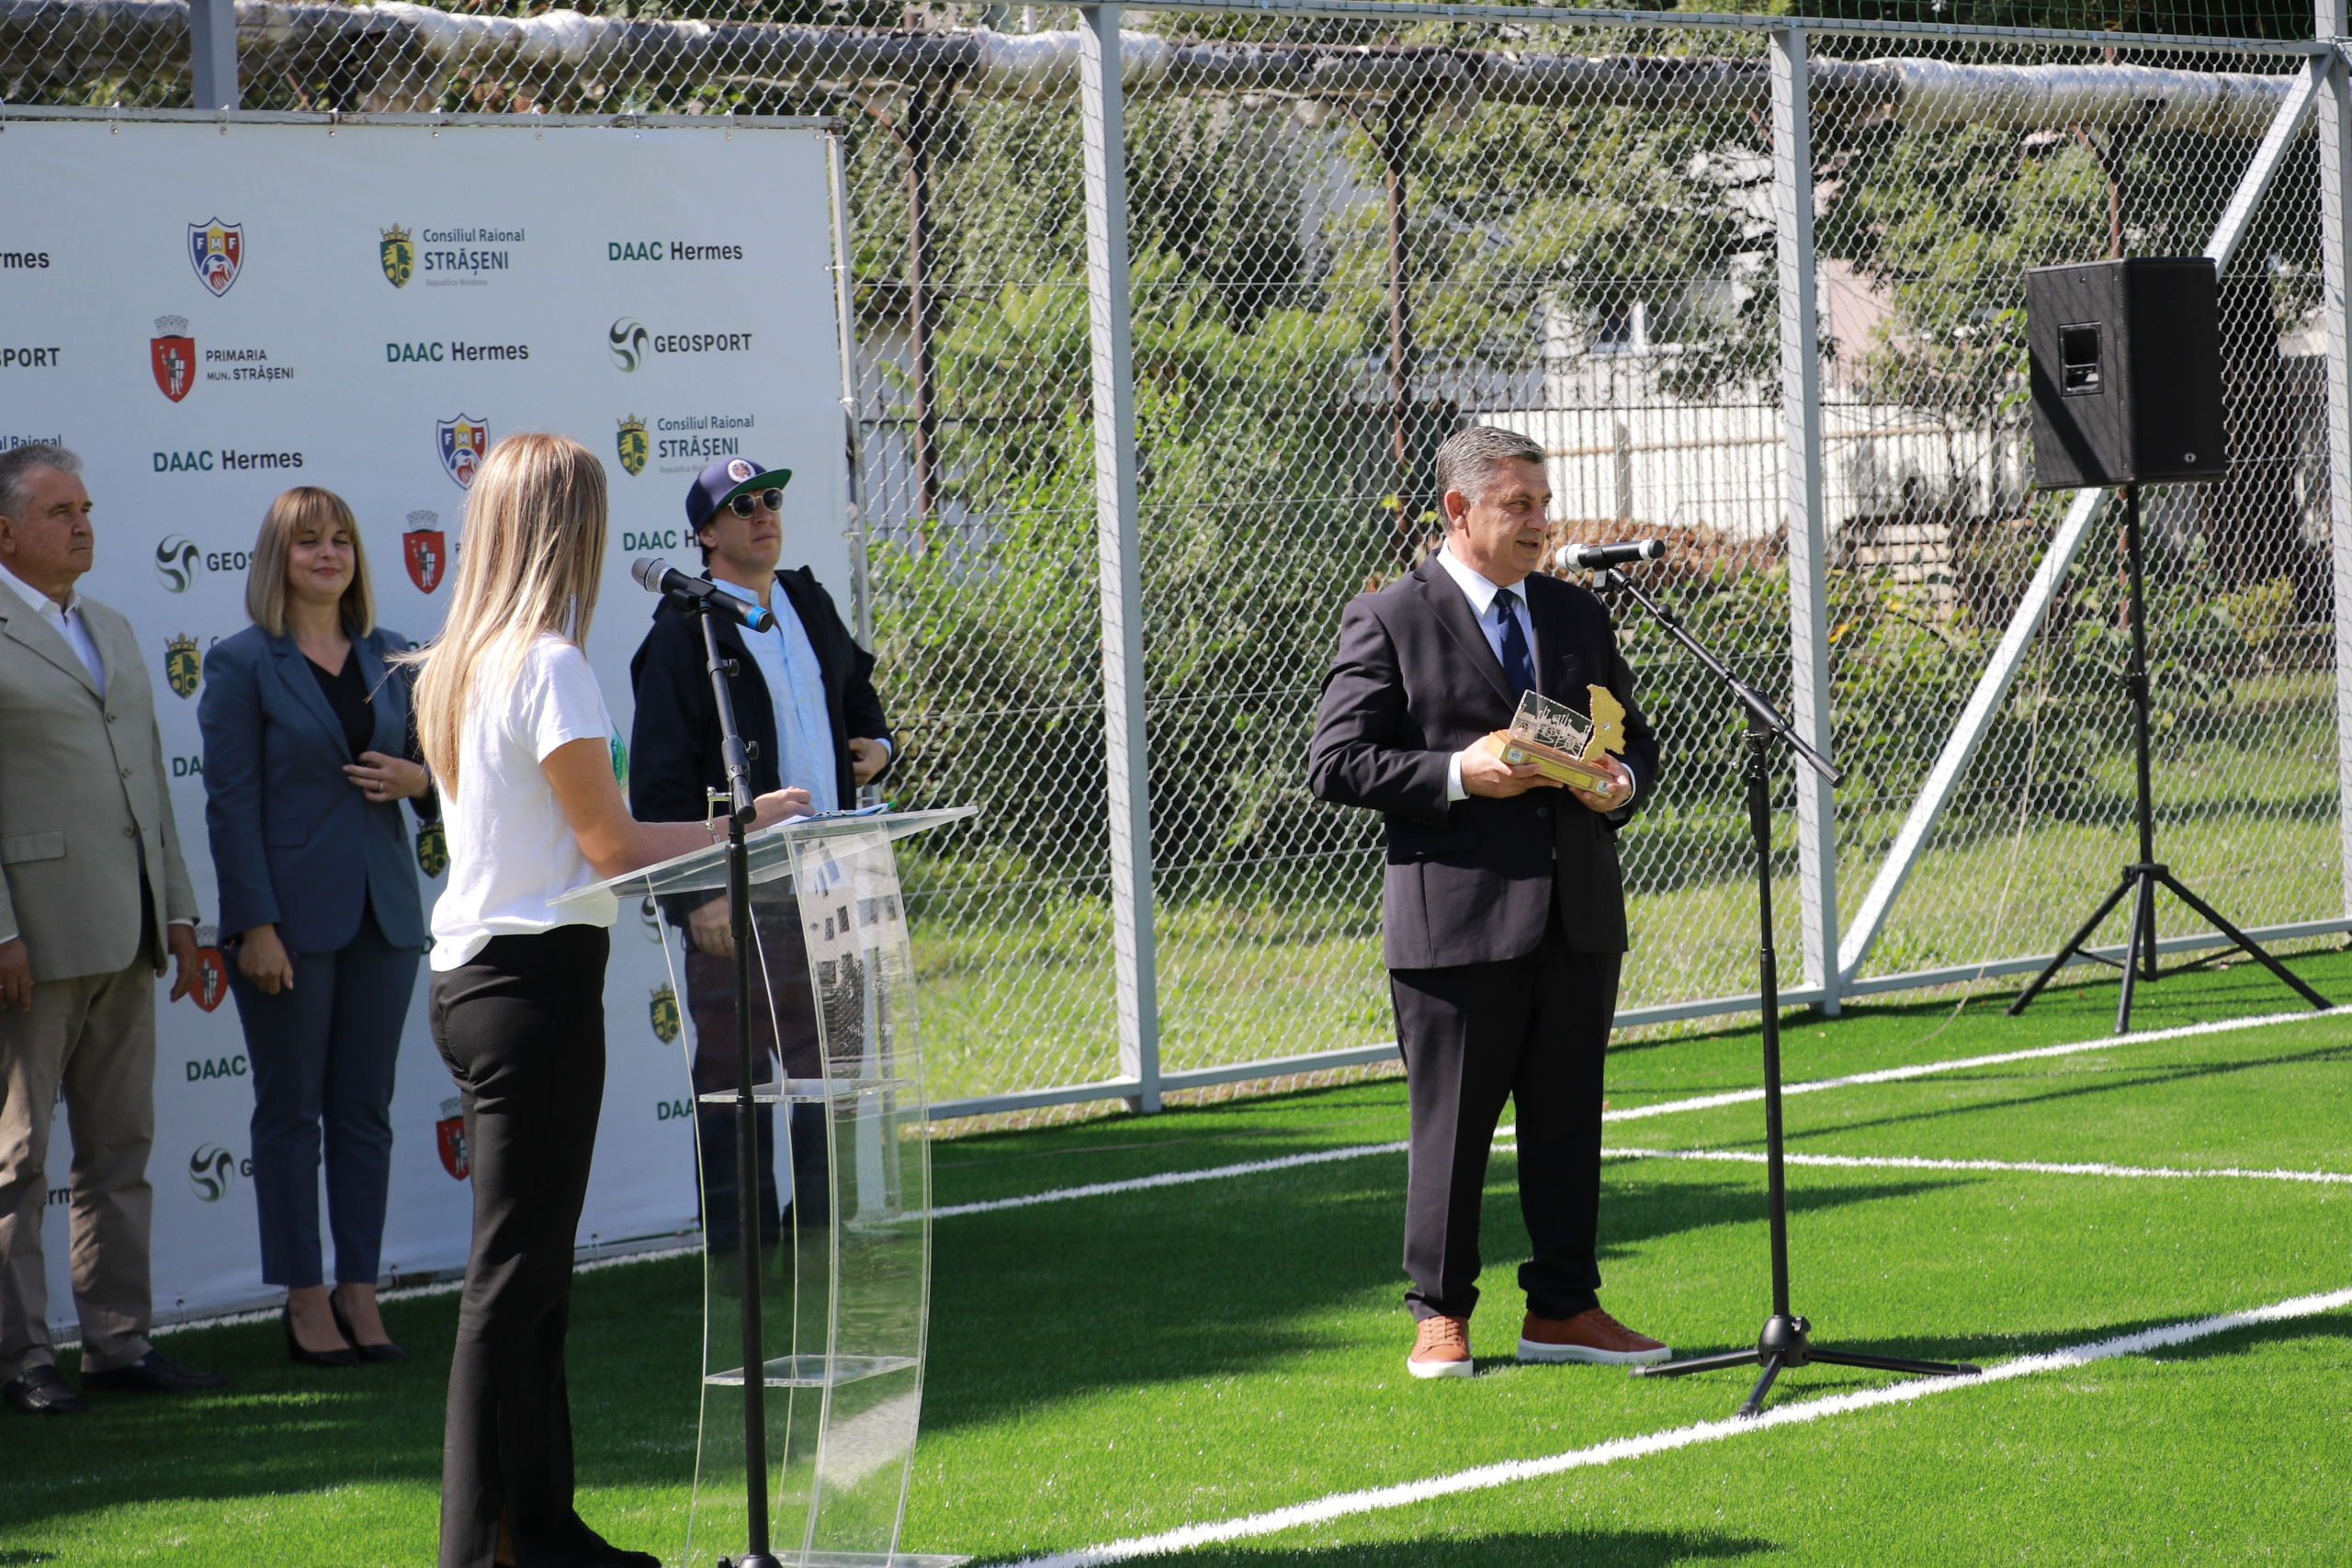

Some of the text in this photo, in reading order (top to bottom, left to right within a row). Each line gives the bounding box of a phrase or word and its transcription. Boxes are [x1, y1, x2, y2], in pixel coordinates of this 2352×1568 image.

[196, 236, 237, 251] FMF
[423, 228, 525, 243] Consiliul Raional
[0, 252, 50, 268] mes
[608, 241, 743, 261] DAAC Hermes
[424, 247, 509, 276] STRĂȘENI
[386, 342, 529, 362] DAAC Hermes
[654, 333, 752, 353] GEOSPORT
[0, 347, 61, 367] PORT
[206, 350, 267, 362] PRIMARIA
[233, 365, 294, 382] STRĂȘENI
[658, 414, 754, 431] Consiliul Raional
[444, 431, 482, 446] FMF
[659, 435, 739, 461] STRĂȘENI
[153, 450, 303, 472] DAAC Hermes
[623, 530, 677, 551] DAAC
[206, 551, 254, 571] GEO
[187, 1055, 246, 1081] DAAC
[658, 1098, 695, 1121] DAA
